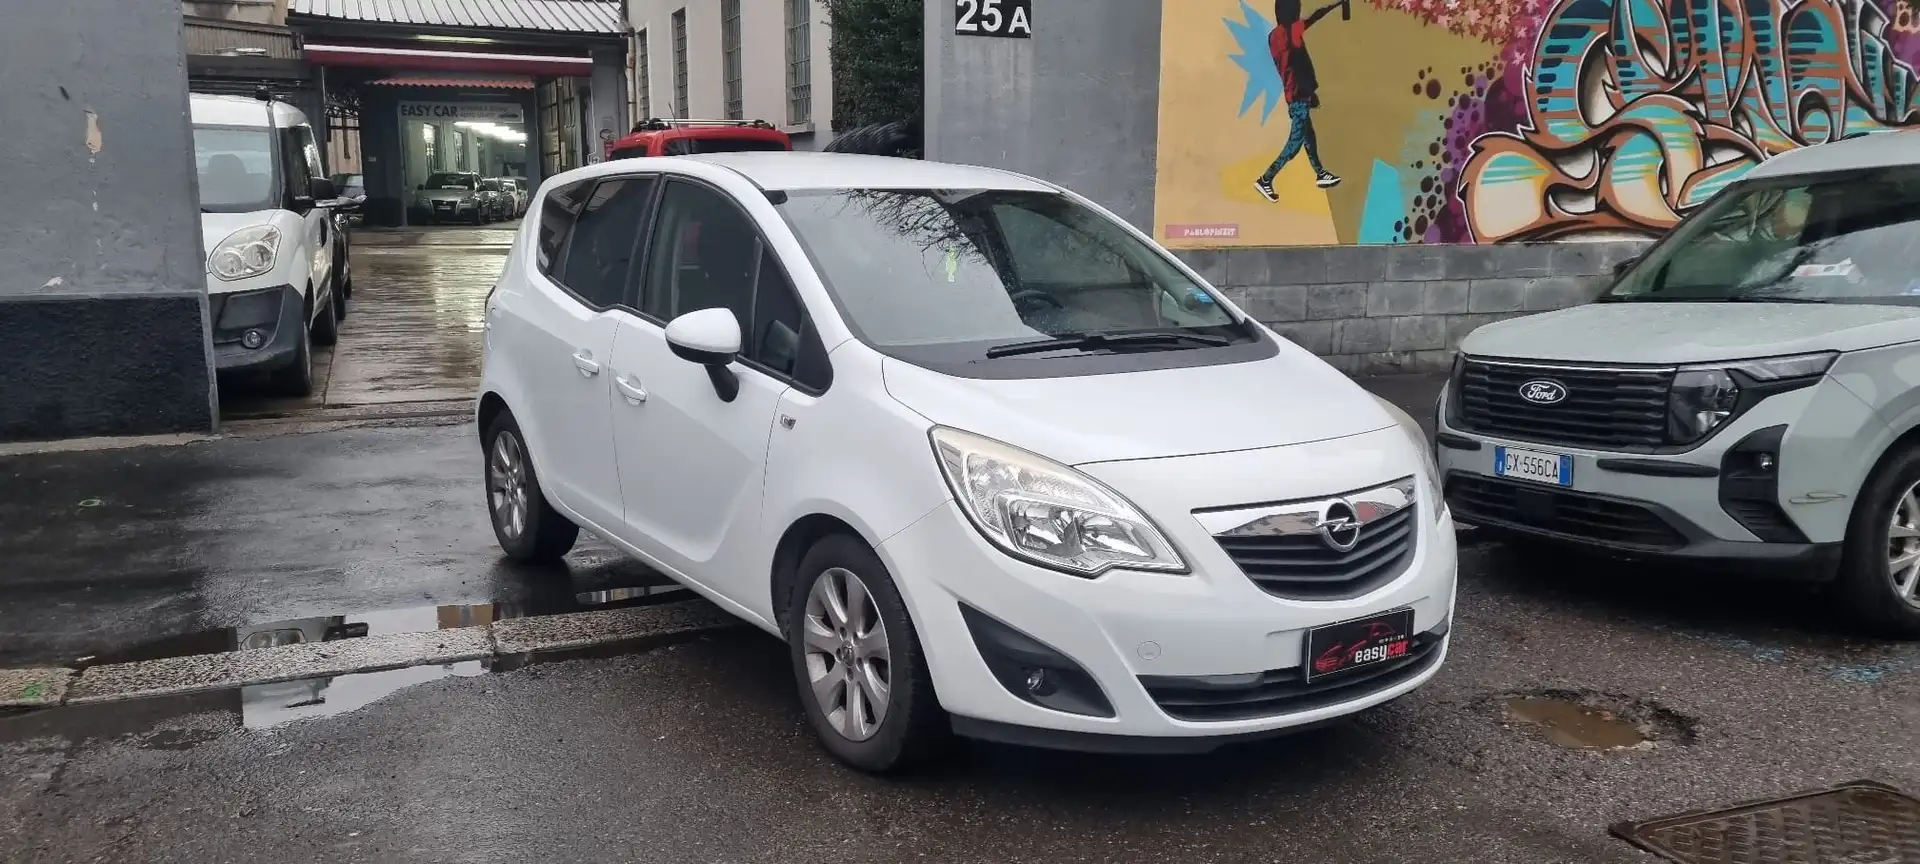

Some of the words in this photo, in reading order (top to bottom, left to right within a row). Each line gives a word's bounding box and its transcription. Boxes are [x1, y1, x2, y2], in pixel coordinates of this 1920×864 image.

[956, 0, 1002, 32] 25
[1008, 6, 1031, 34] A
[401, 105, 430, 117] EASY
[433, 105, 458, 117] CAR
[1527, 383, 1557, 401] Ford
